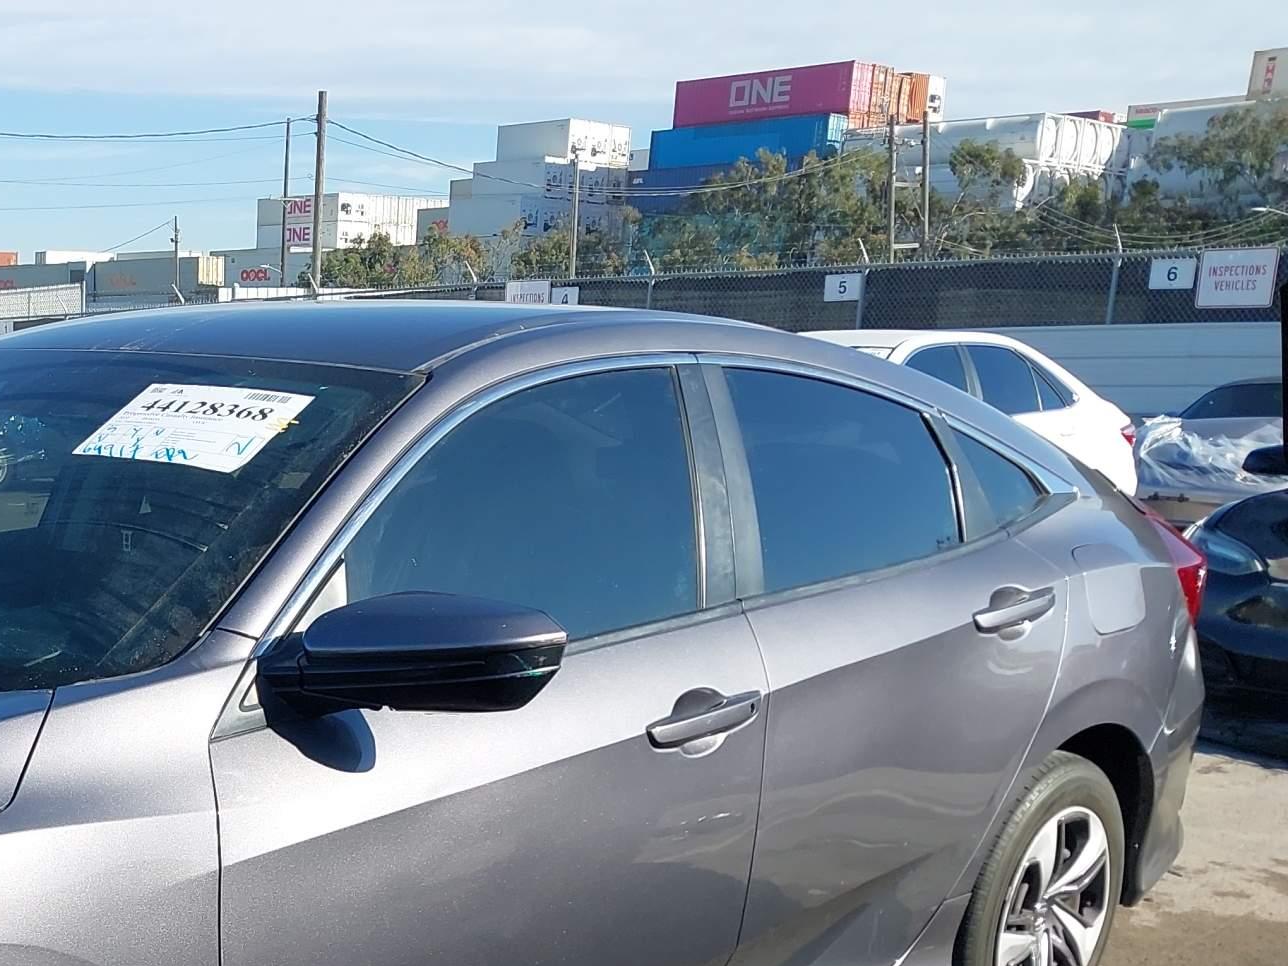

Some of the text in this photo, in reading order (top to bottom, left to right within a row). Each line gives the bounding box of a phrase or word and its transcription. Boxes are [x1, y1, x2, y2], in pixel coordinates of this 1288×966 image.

[729, 75, 793, 107] ONE
[1167, 266, 1179, 282] 6
[1208, 264, 1268, 277] INSPECTIONS
[838, 280, 848, 295] 5
[1214, 279, 1258, 292] VEHICLES
[140, 398, 275, 422] 44128368
